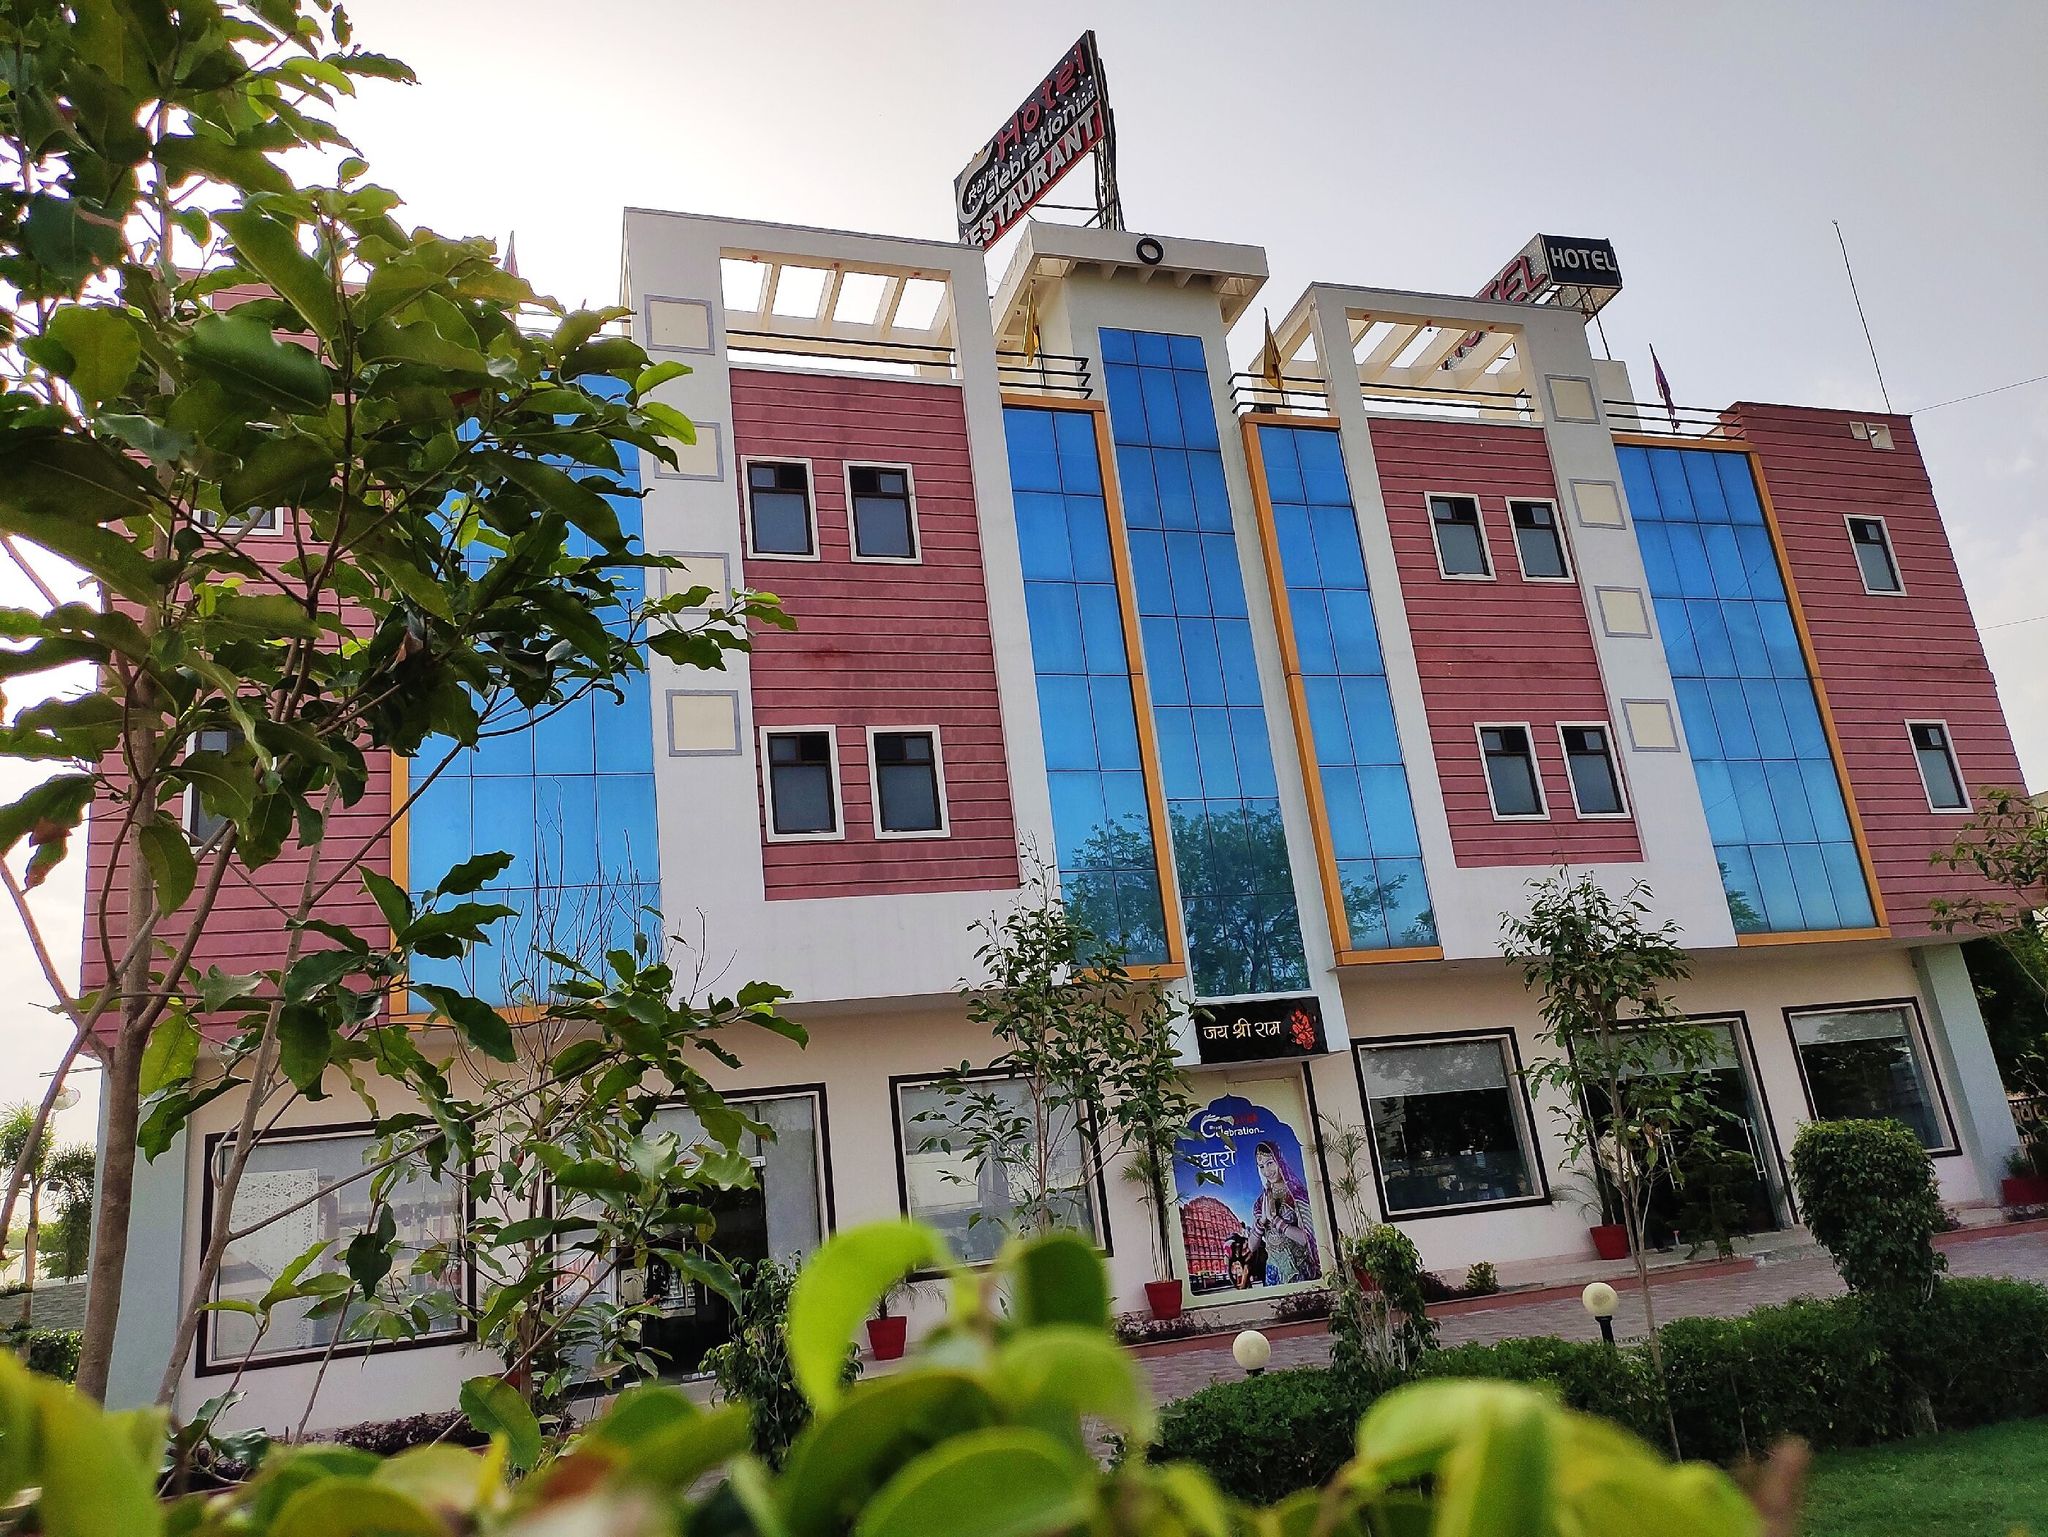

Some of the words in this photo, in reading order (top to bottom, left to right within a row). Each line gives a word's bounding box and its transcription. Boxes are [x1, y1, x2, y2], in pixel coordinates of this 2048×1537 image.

[998, 43, 1085, 162] Hotel
[957, 104, 1076, 224] Celebration
[967, 164, 999, 205] Royal
[1549, 247, 1617, 271] HOTEL
[1202, 1025, 1229, 1040] जय
[1232, 1017, 1251, 1039] श्री
[1254, 1021, 1281, 1038] राम
[1192, 1144, 1235, 1168] धारो
